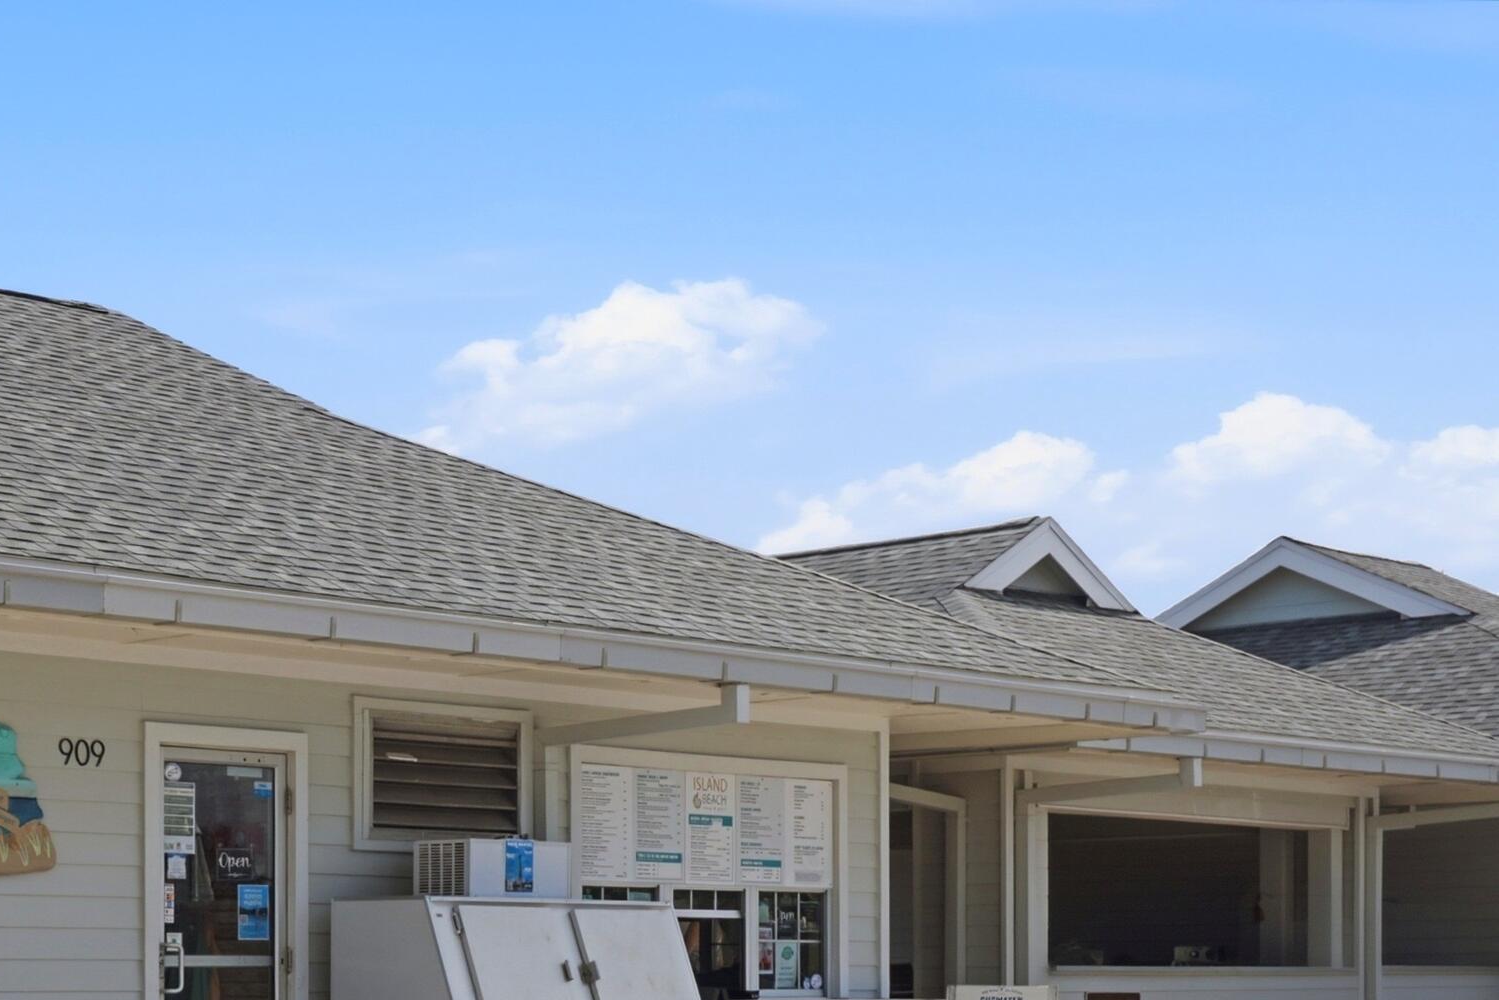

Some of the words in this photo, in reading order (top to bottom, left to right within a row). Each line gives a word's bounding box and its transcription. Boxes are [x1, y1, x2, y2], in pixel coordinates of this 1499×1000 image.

[58, 737, 105, 767] 909
[692, 776, 728, 793] ISLAND
[701, 793, 727, 806] BEACH
[218, 851, 251, 873] Open
